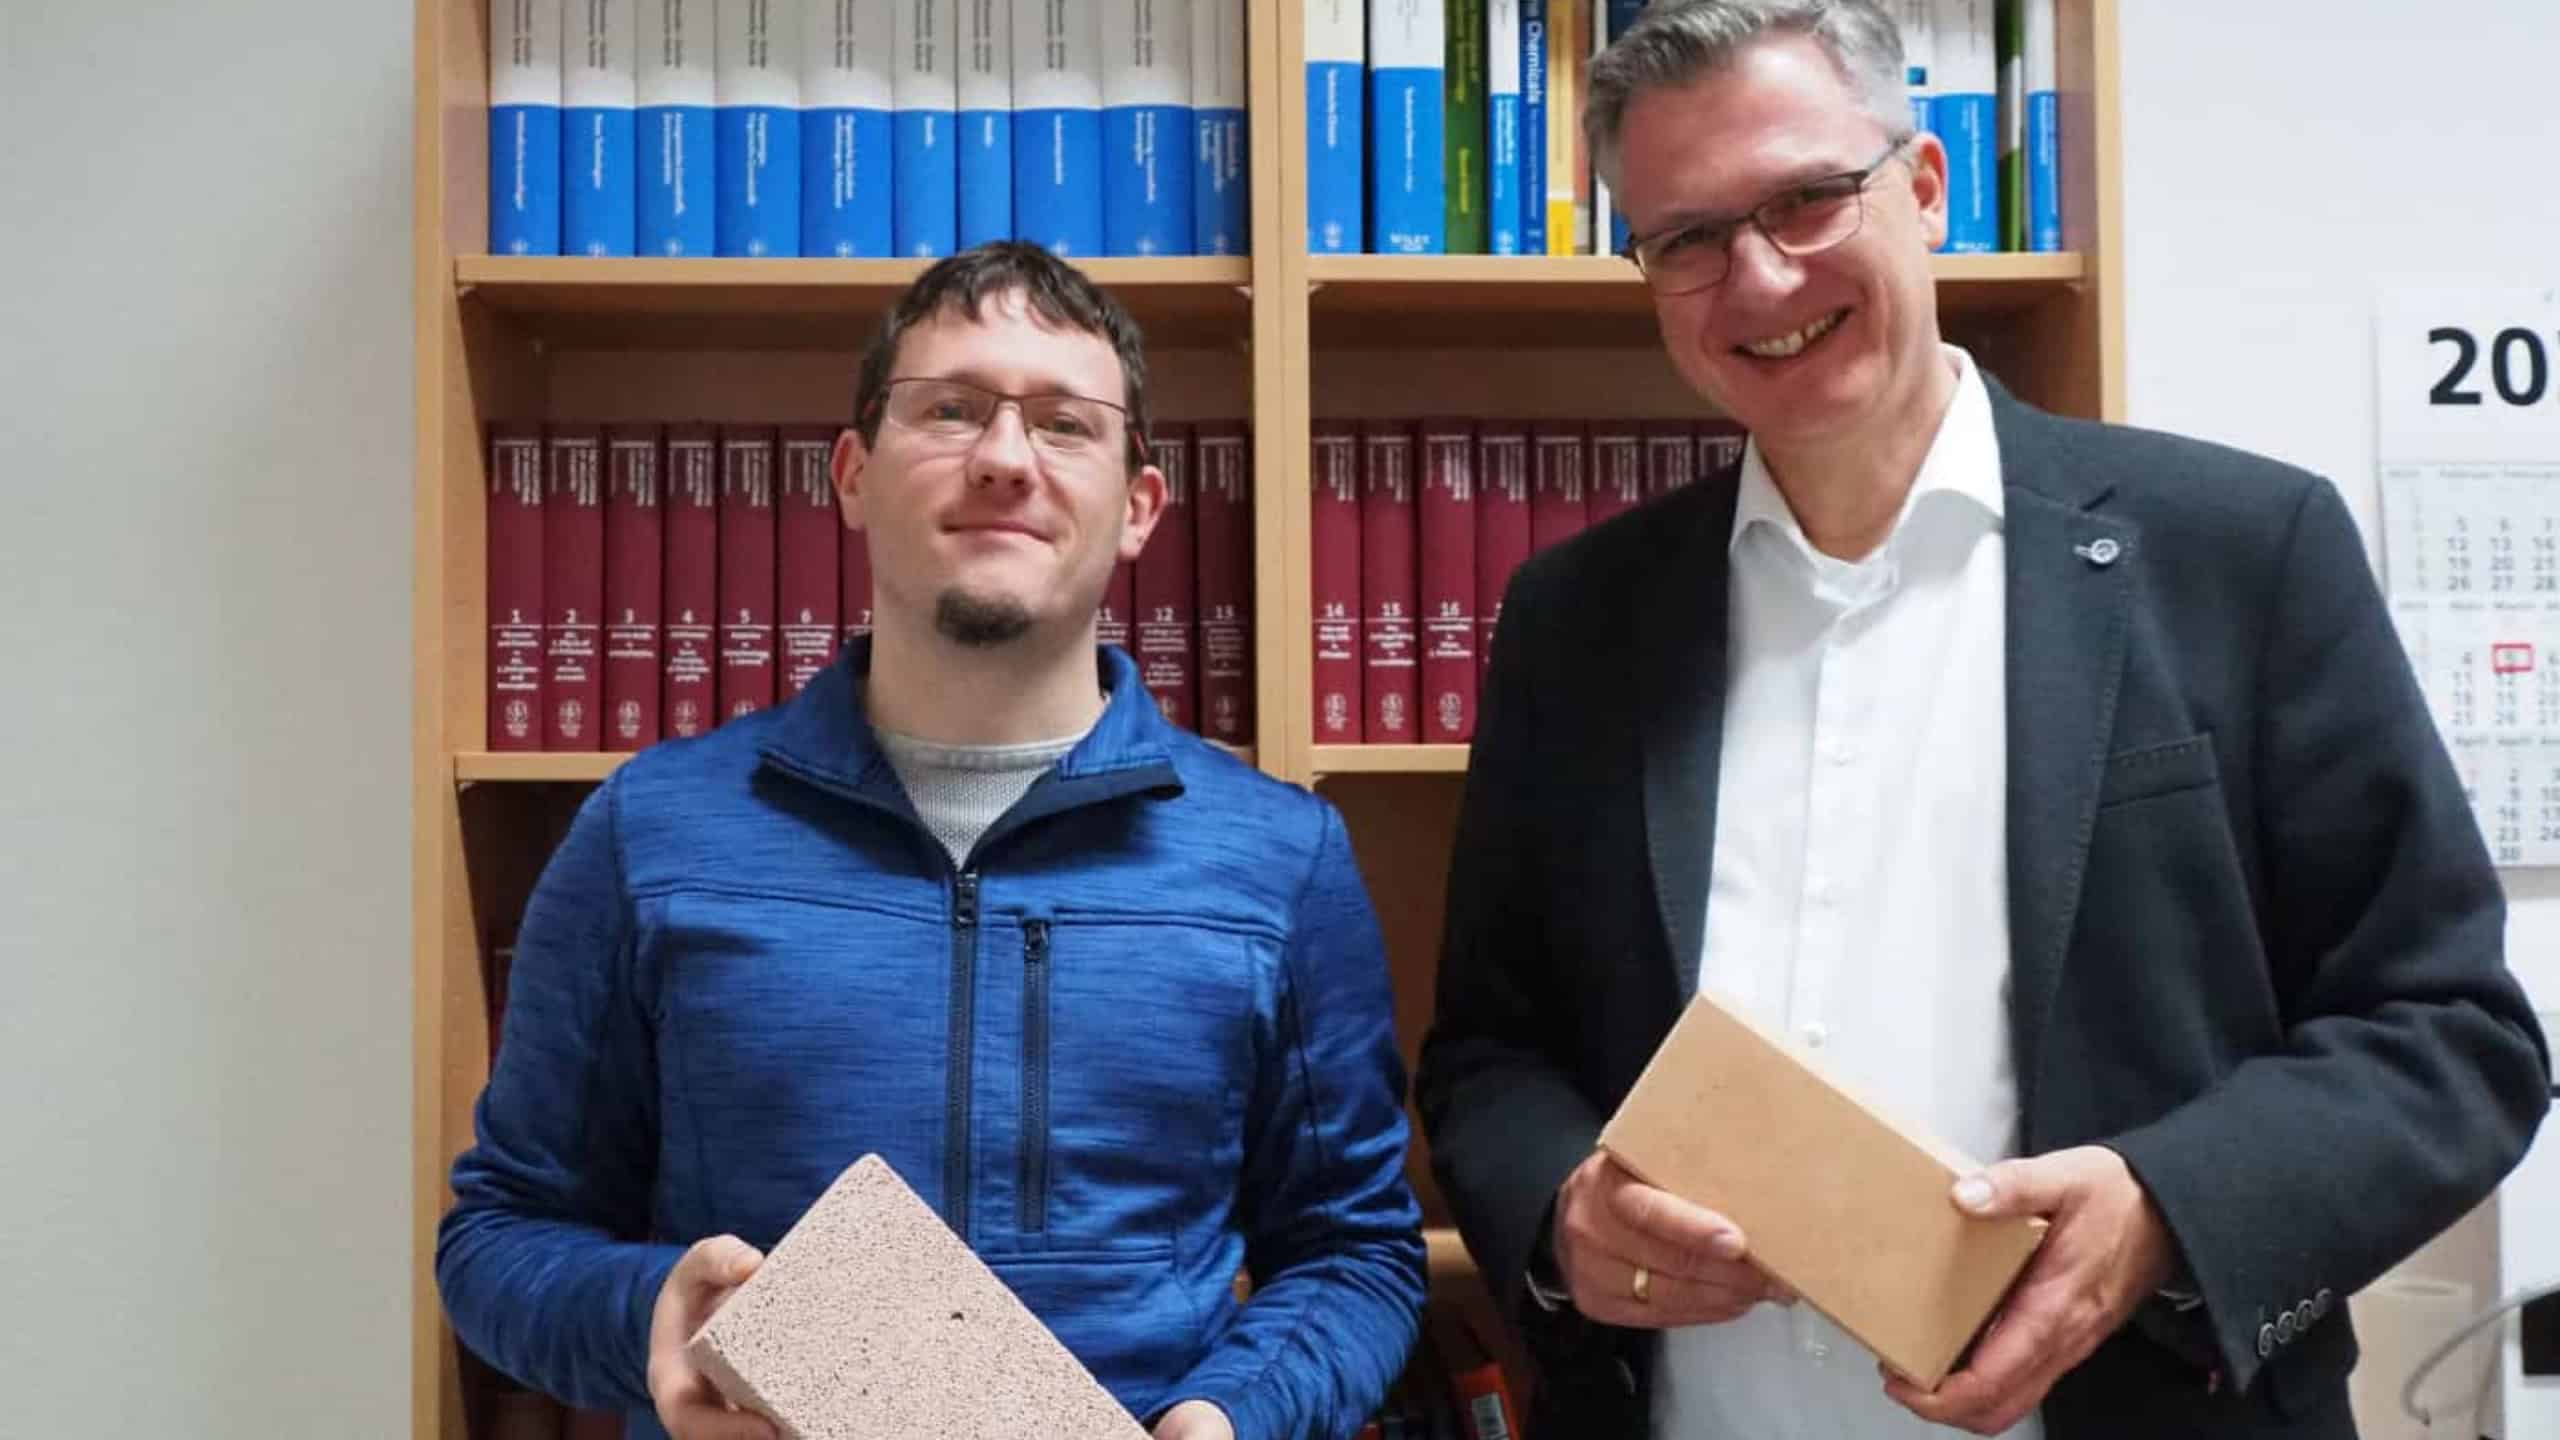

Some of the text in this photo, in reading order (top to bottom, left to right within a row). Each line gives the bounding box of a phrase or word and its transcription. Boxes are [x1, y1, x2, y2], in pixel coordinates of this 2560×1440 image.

[1527, 21, 1543, 104] Chemicals
[2428, 327, 2560, 407] 20
[511, 608, 521, 624] 1
[566, 608, 576, 624] 2
[624, 608, 635, 624] 3
[681, 608, 693, 624] 4
[800, 608, 812, 624] 6
[1155, 607, 1175, 622] 12
[1324, 602, 1345, 618] 14
[1382, 602, 1402, 618] 15
[1440, 602, 1460, 618] 16
